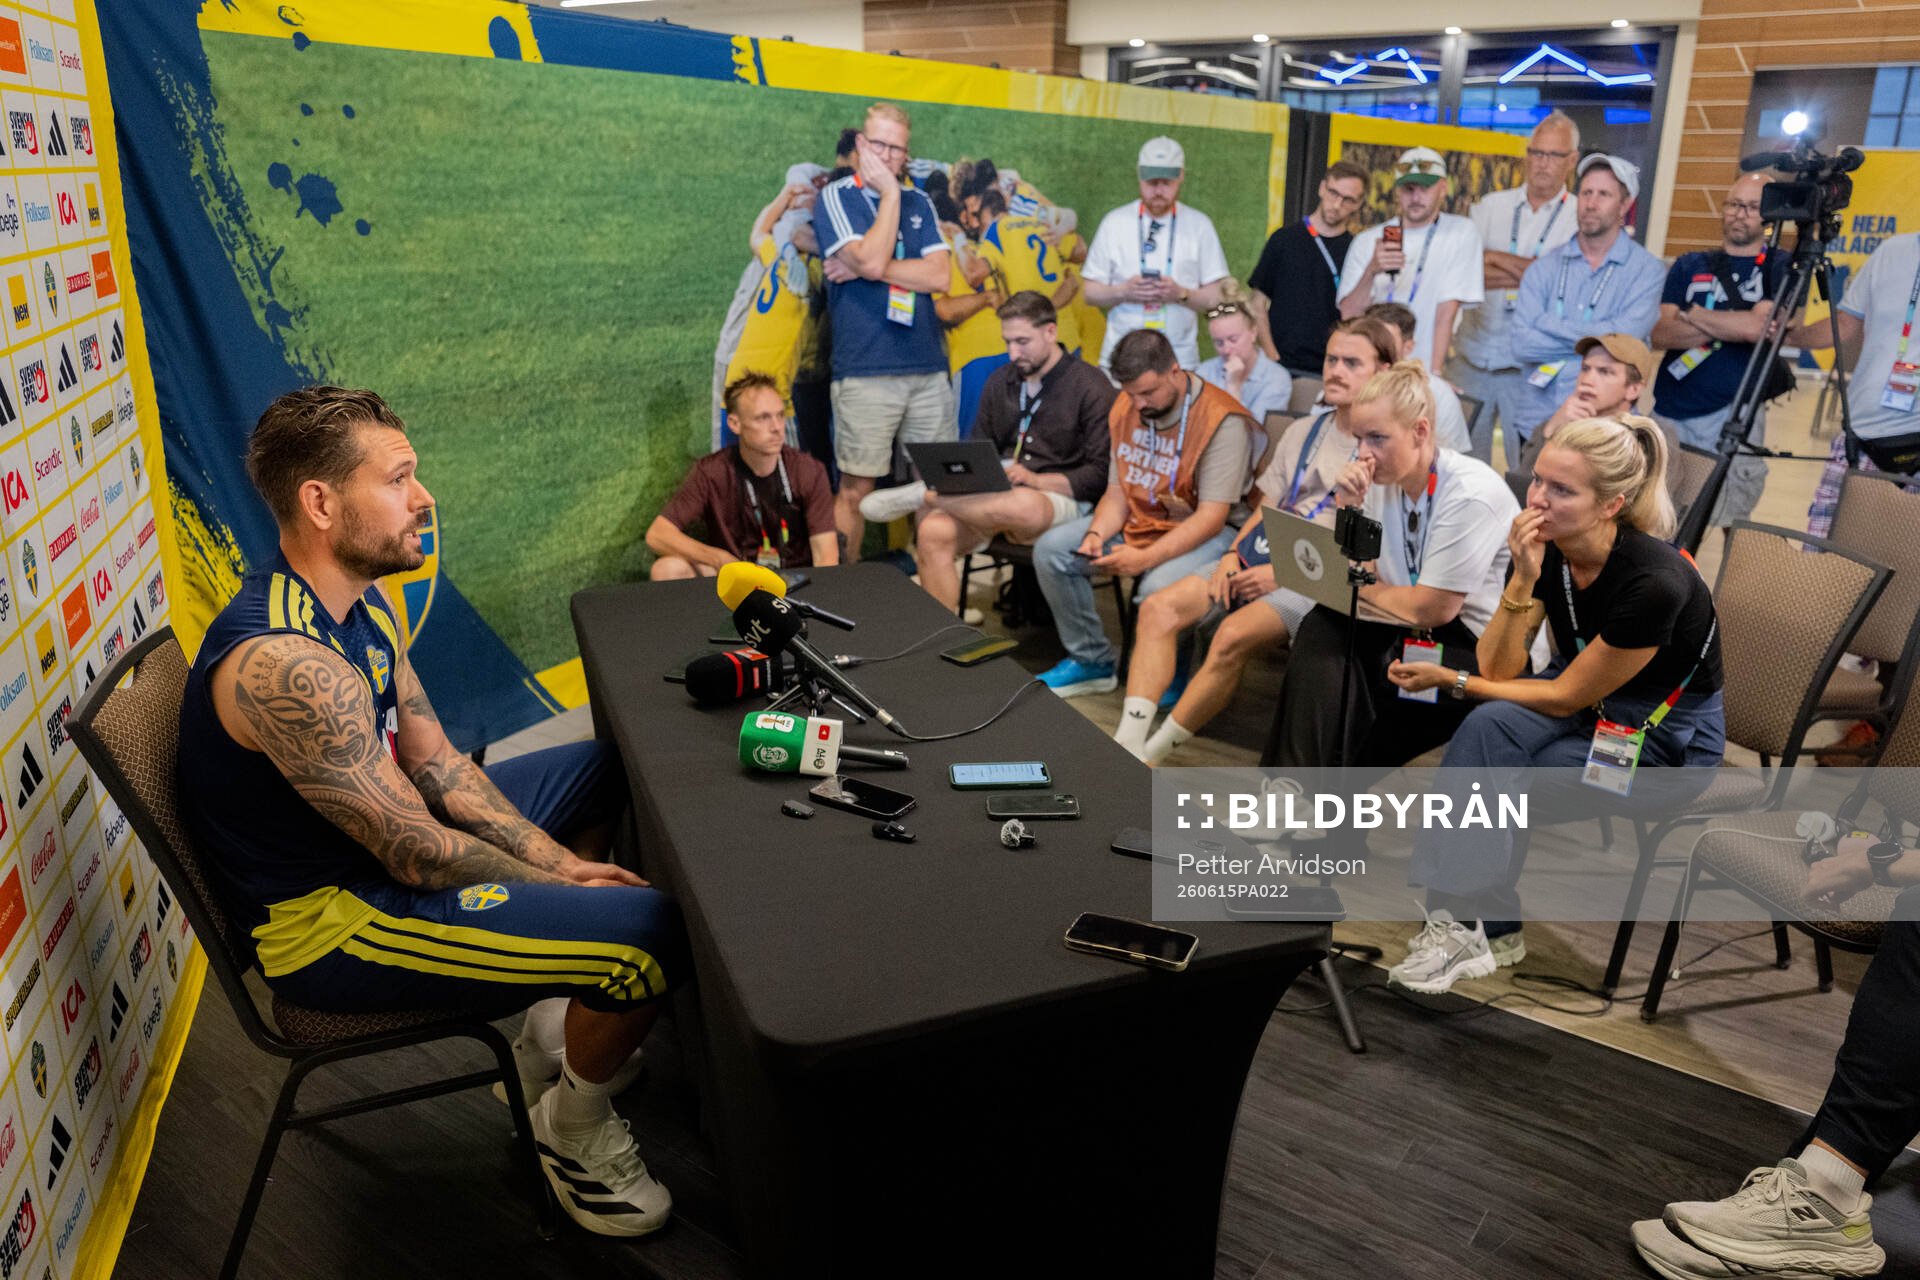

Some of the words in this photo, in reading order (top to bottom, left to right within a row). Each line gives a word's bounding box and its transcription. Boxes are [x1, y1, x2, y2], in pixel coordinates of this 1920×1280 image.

[13, 130, 27, 149] SPEL
[24, 202, 51, 223] Folksam
[56, 192, 78, 225] ICA
[1853, 215, 1896, 233] HEJA
[1027, 234, 1057, 282] 2
[67, 273, 91, 291] BAUHAUS
[19, 359, 45, 387] SVENSKA
[23, 383, 38, 407] SPEL
[35, 448, 62, 481] Scandic
[1, 467, 30, 515] ICA
[49, 524, 78, 562] BAUHAUS
[116, 542, 136, 574] Scandic
[93, 565, 113, 608] ICA
[744, 618, 771, 649] svt
[0, 671, 27, 711] olksam
[78, 852, 101, 899] Scandic
[43, 896, 75, 962] BAUHAUS
[61, 977, 87, 1036] ICA
[90, 1114, 114, 1176] Scandic
[56, 1187, 87, 1261] Folksam
